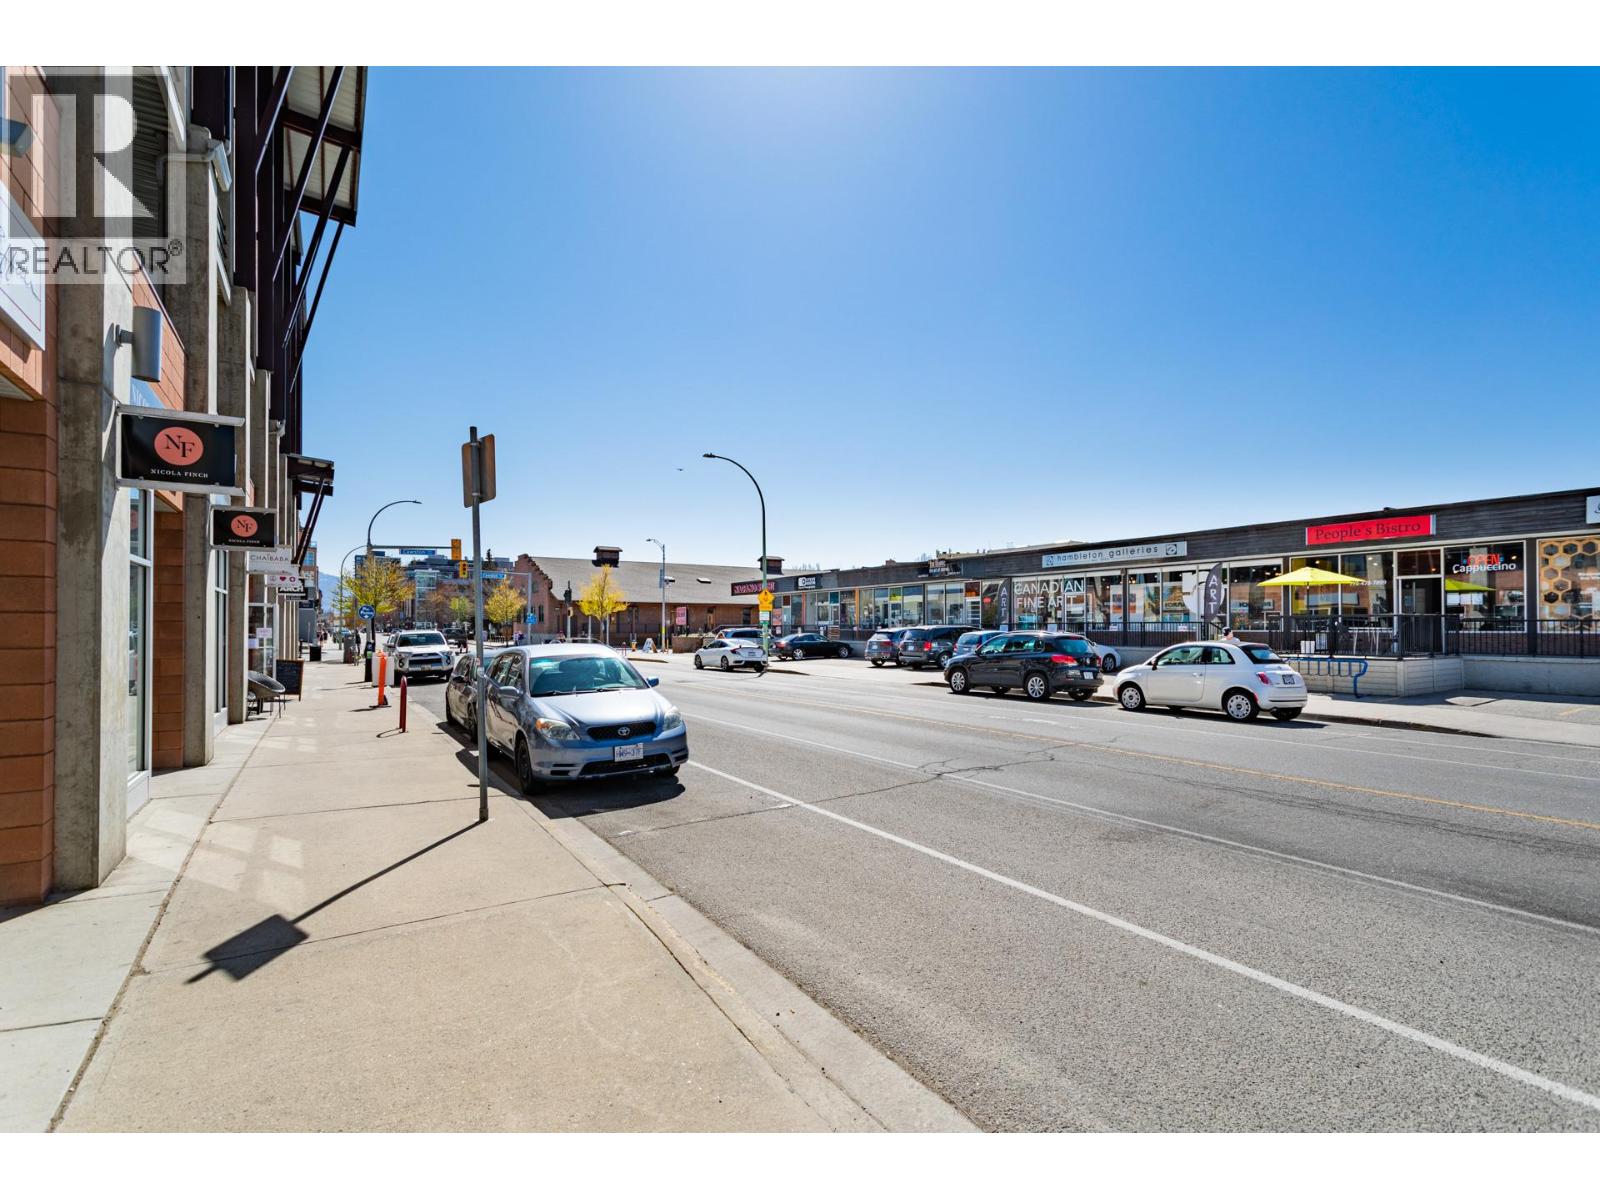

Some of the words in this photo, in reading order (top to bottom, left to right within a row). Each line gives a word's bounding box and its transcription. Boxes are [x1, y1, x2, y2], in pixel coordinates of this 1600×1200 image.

[150, 468, 182, 477] NICOLA
[184, 471, 209, 479] FINCH
[1315, 525, 1373, 541] People's
[1376, 521, 1421, 535] Bistro
[1056, 551, 1104, 561] hambleton
[1108, 545, 1159, 559] galleries
[1467, 553, 1500, 566] OPEN
[1452, 562, 1517, 575] Cappuccino
[1014, 580, 1084, 595] CANADIAN
[1208, 575, 1219, 614] ART
[1000, 587, 1008, 617] ART
[1016, 596, 1045, 609] FINE
[1047, 595, 1077, 609] ART
